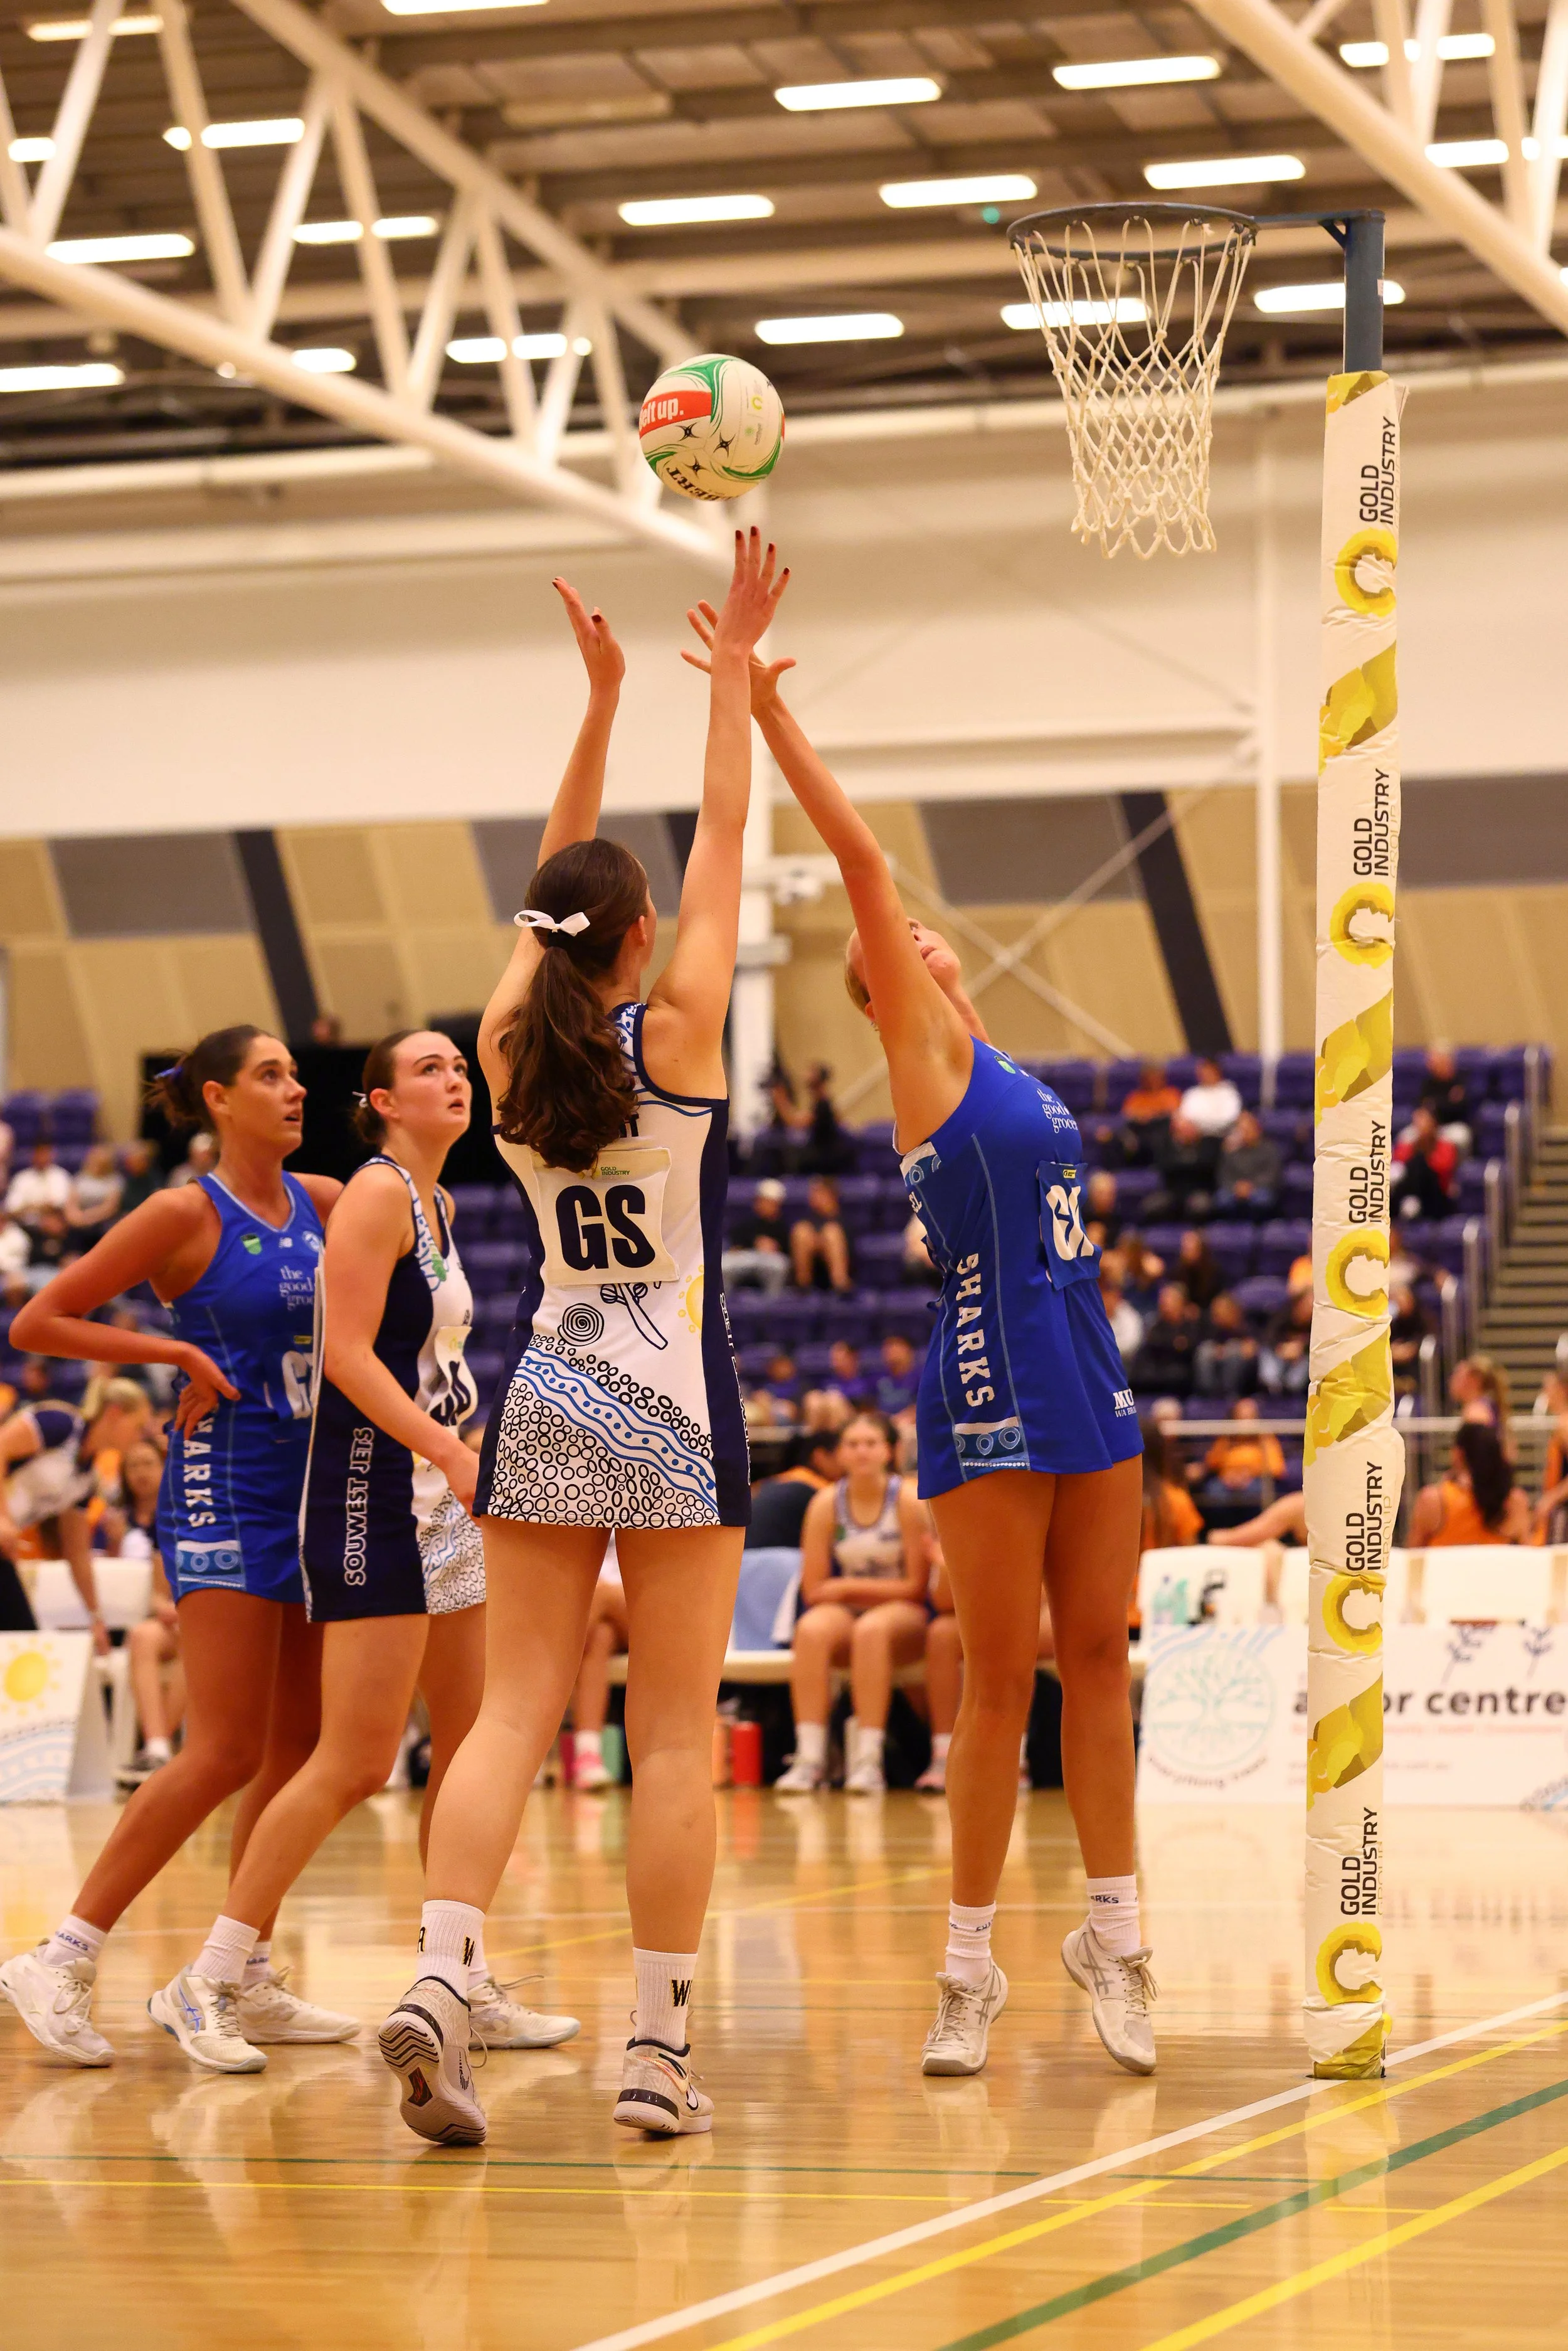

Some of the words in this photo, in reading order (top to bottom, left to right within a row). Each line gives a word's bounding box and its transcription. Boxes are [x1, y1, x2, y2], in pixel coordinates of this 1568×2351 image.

[639, 400, 655, 430] elt
[658, 398, 684, 420] up.
[1359, 464, 1379, 523] GOLD
[1380, 415, 1396, 525] INDUSTRY
[1353, 817, 1372, 876] GOLD
[1374, 768, 1389, 876] INDUSTRY
[1042, 1101, 1067, 1119] good
[1348, 1166, 1369, 1223] GOLD
[1369, 1120, 1386, 1223] INDUSTRY
[556, 1184, 655, 1271] GS
[279, 1277, 314, 1297] good
[280, 1265, 304, 1280] the
[955, 1252, 995, 1408] SHARKS
[349, 1426, 375, 1475] JETS
[343, 1477, 369, 1586] SOUWEST
[1346, 1512, 1365, 1571] GOLD
[1366, 1460, 1382, 1571] INDUSTRY
[1426, 1685, 1567, 1716] centre
[1340, 1856, 1361, 1916] GOLD
[1362, 1807, 1378, 1915] INDUSTRY
